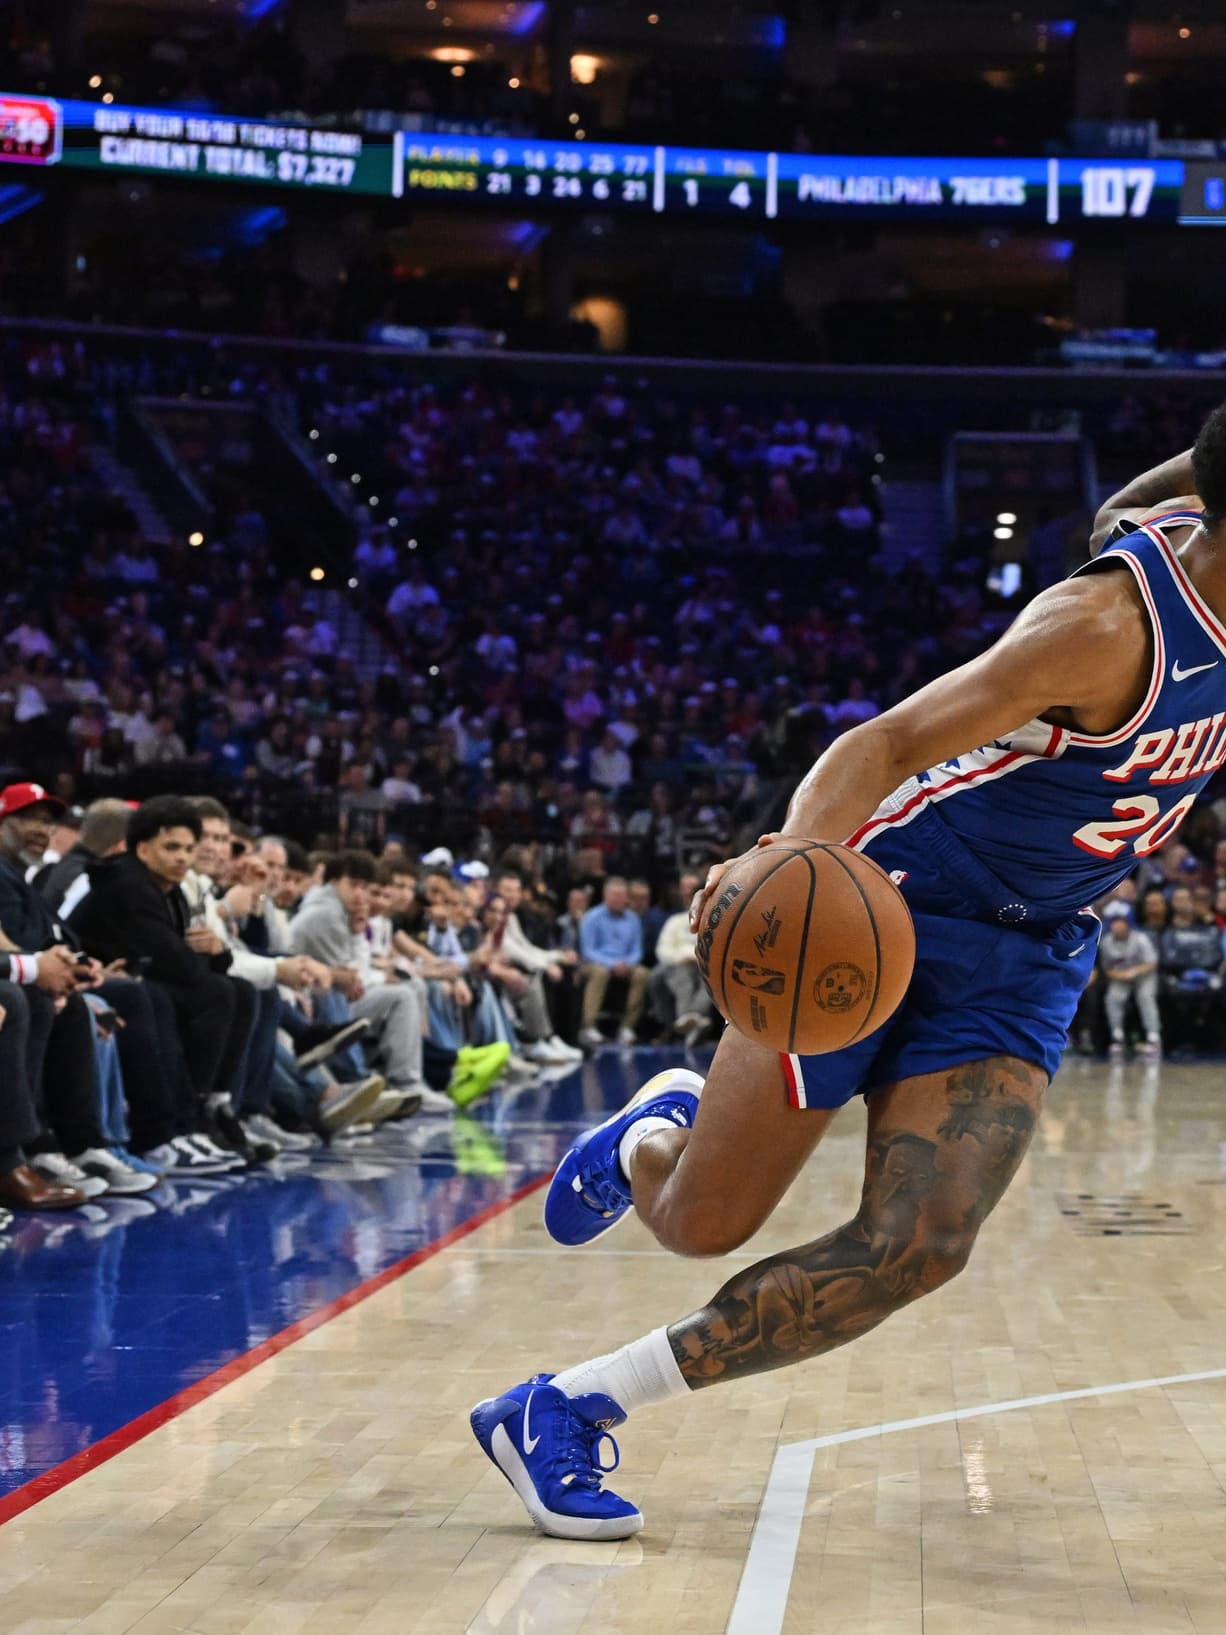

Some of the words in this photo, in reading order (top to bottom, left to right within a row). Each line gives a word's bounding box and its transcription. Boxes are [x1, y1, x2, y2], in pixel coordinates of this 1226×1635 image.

[682, 178, 699, 206] 1
[728, 181, 751, 209] 4
[797, 174, 943, 205] PHILADELPHIA
[949, 175, 1026, 206] 76ERS
[1081, 167, 1155, 217] 107
[1072, 793, 1197, 860] 20
